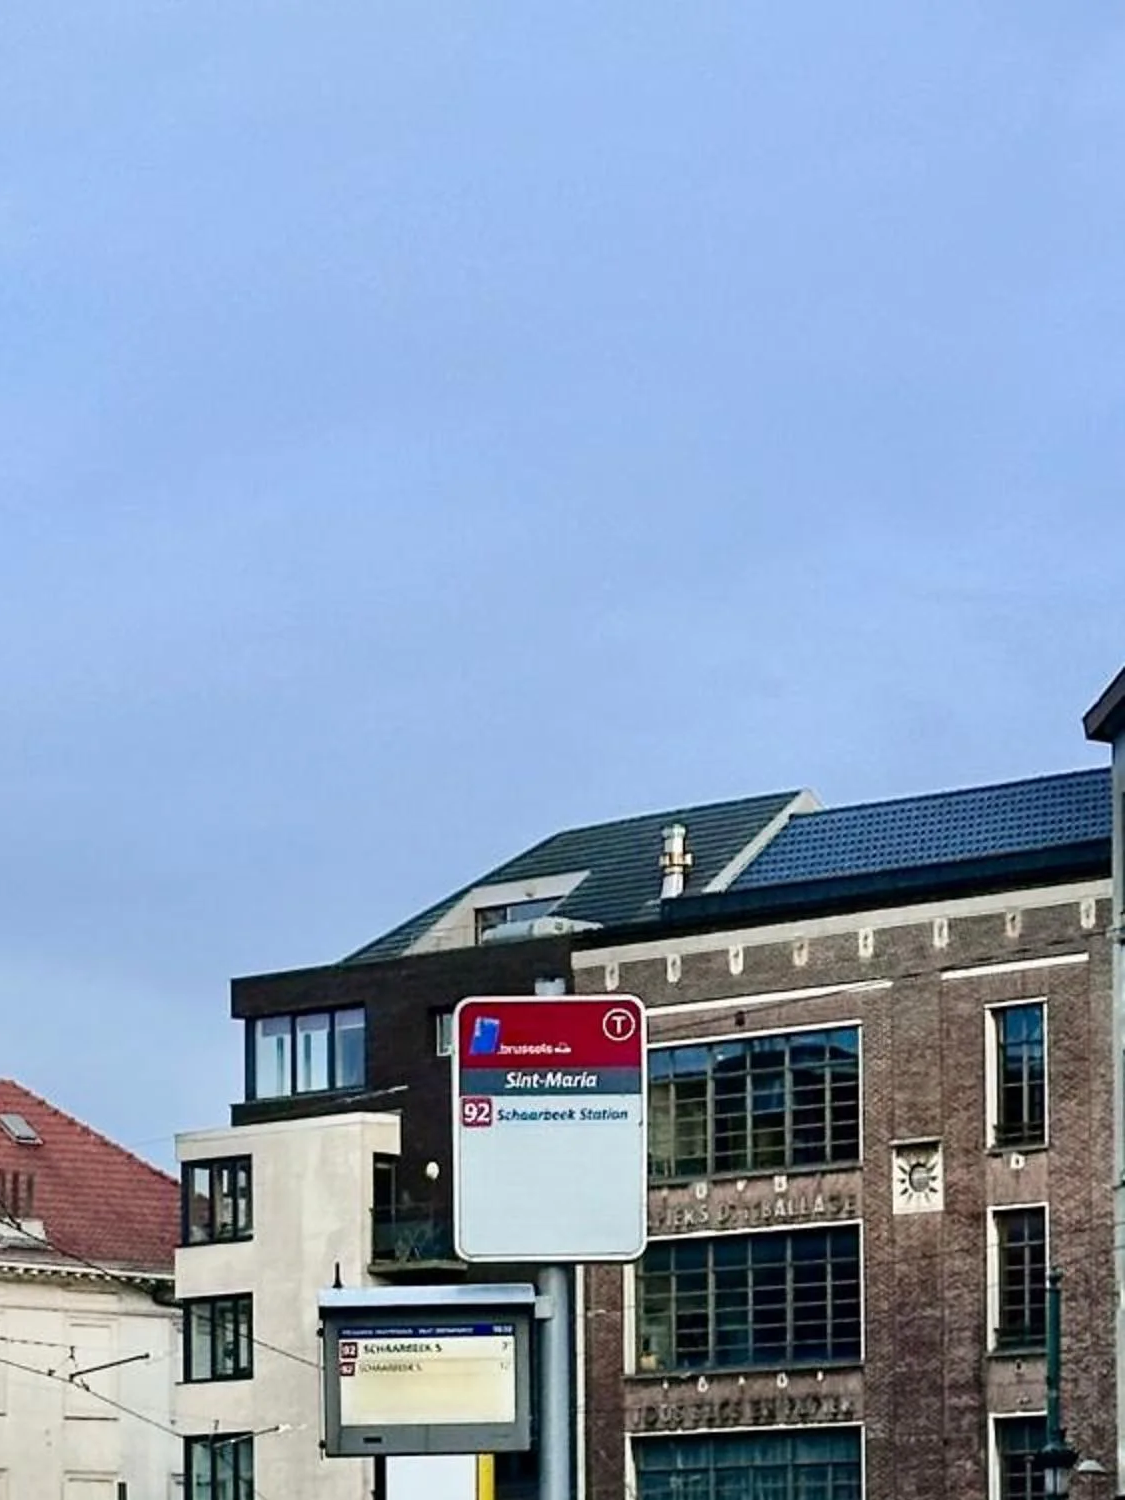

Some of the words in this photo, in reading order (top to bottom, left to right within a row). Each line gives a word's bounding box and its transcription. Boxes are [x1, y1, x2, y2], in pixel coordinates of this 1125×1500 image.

[504, 1071, 598, 1089] Sint-Maria
[463, 1103, 491, 1123] 92
[496, 1108, 576, 1121] Schaarbeek
[579, 1107, 629, 1121] Station
